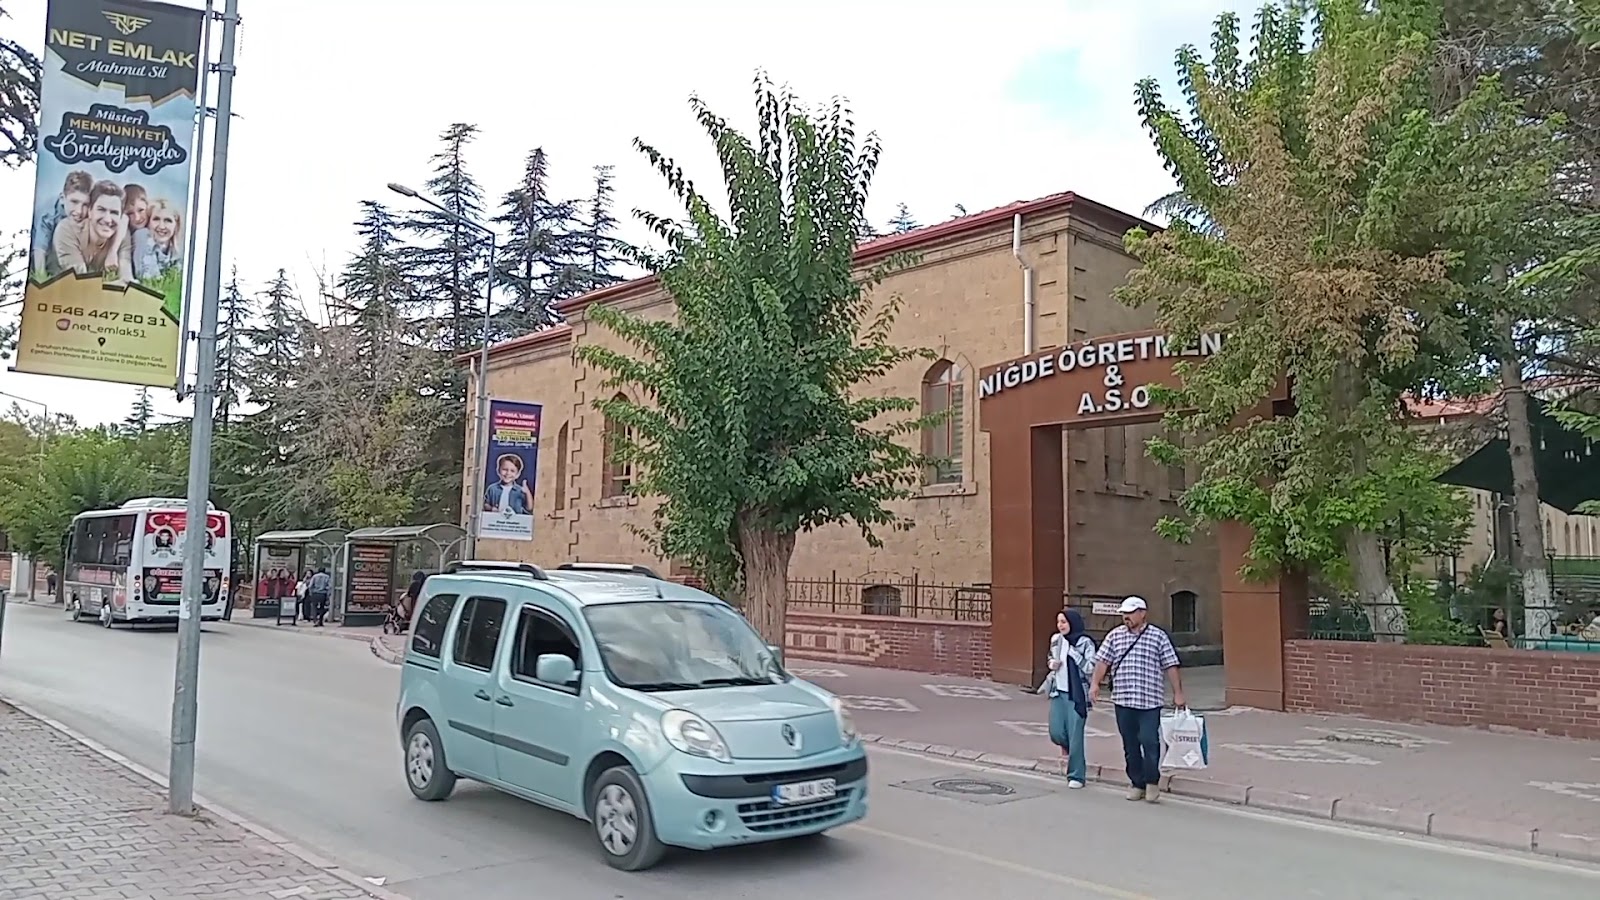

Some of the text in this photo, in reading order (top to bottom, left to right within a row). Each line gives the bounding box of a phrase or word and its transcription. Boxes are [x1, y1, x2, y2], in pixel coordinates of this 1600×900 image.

[49, 28, 196, 69] NET EMLAK
[69, 118, 166, 142] MEMNUNİYETİ
[37, 302, 167, 327] 0 546 447 20 31
[979, 353, 1055, 399] NİĞDE
[1103, 363, 1125, 387] &
